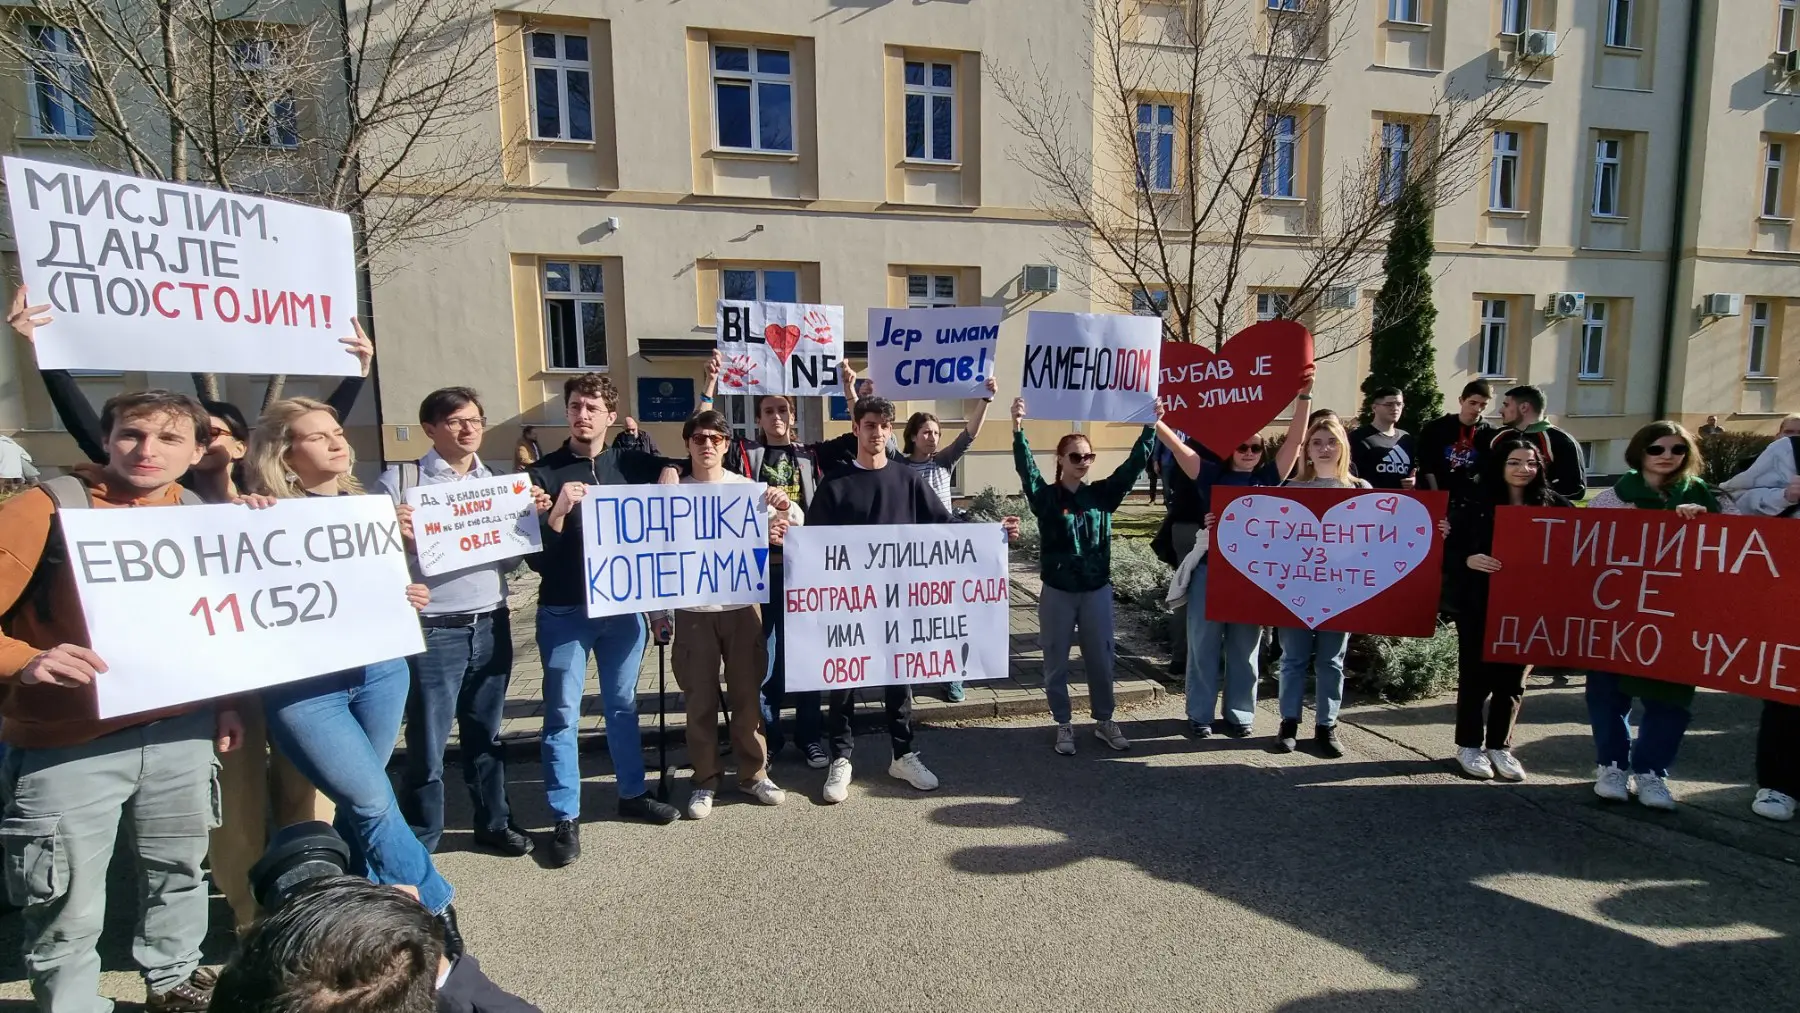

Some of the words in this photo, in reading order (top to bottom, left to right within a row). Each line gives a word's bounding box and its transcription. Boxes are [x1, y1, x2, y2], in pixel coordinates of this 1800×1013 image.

[24, 168, 279, 243] МИСЛИМ,
[37, 221, 240, 280] ДАКЛЕ
[48, 271, 332, 329] (ПО)СТОЈИМ!
[875, 316, 922, 351] Јер
[935, 322, 999, 344] имам
[894, 347, 987, 387] став!
[1023, 344, 1152, 392] КАМЕНОЛОМ
[1249, 355, 1272, 376] ЈЕ
[1198, 384, 1263, 408] УЛИЦИ
[420, 493, 440, 507] Да
[452, 497, 492, 517] ЗАКОНУ
[424, 521, 441, 536] МИ
[595, 494, 761, 546] ПОДРШКА
[1245, 518, 1397, 544] СТУДЕНТИ
[76, 538, 186, 584] ЕВО
[195, 528, 303, 577] НАС,
[303, 520, 404, 564] СВИХ
[459, 530, 501, 552] ОВДЕ
[824, 544, 851, 571] НА
[864, 538, 977, 570] УЛИЦАМА
[1301, 546, 1328, 564] УЗ
[1531, 518, 1780, 578] ТИШИНА
[587, 547, 769, 605] КОЛЕГАМА!
[1247, 560, 1376, 587] СТУДЕНТЕ
[786, 584, 878, 613] БЕОГРАДА
[885, 583, 899, 608] И
[908, 580, 956, 607] НОВОГ
[962, 577, 1008, 604] САДА
[1592, 569, 1682, 618] СЕ
[827, 622, 865, 648] ИМА
[885, 620, 899, 644] И
[911, 614, 968, 645] ДЈЕЦЕ
[822, 655, 871, 684] ОВОГ
[894, 642, 970, 679] ГРАДА!
[1492, 616, 1662, 666] ДАЛЕКО
[1692, 630, 1800, 693] ЧУЈЕ
